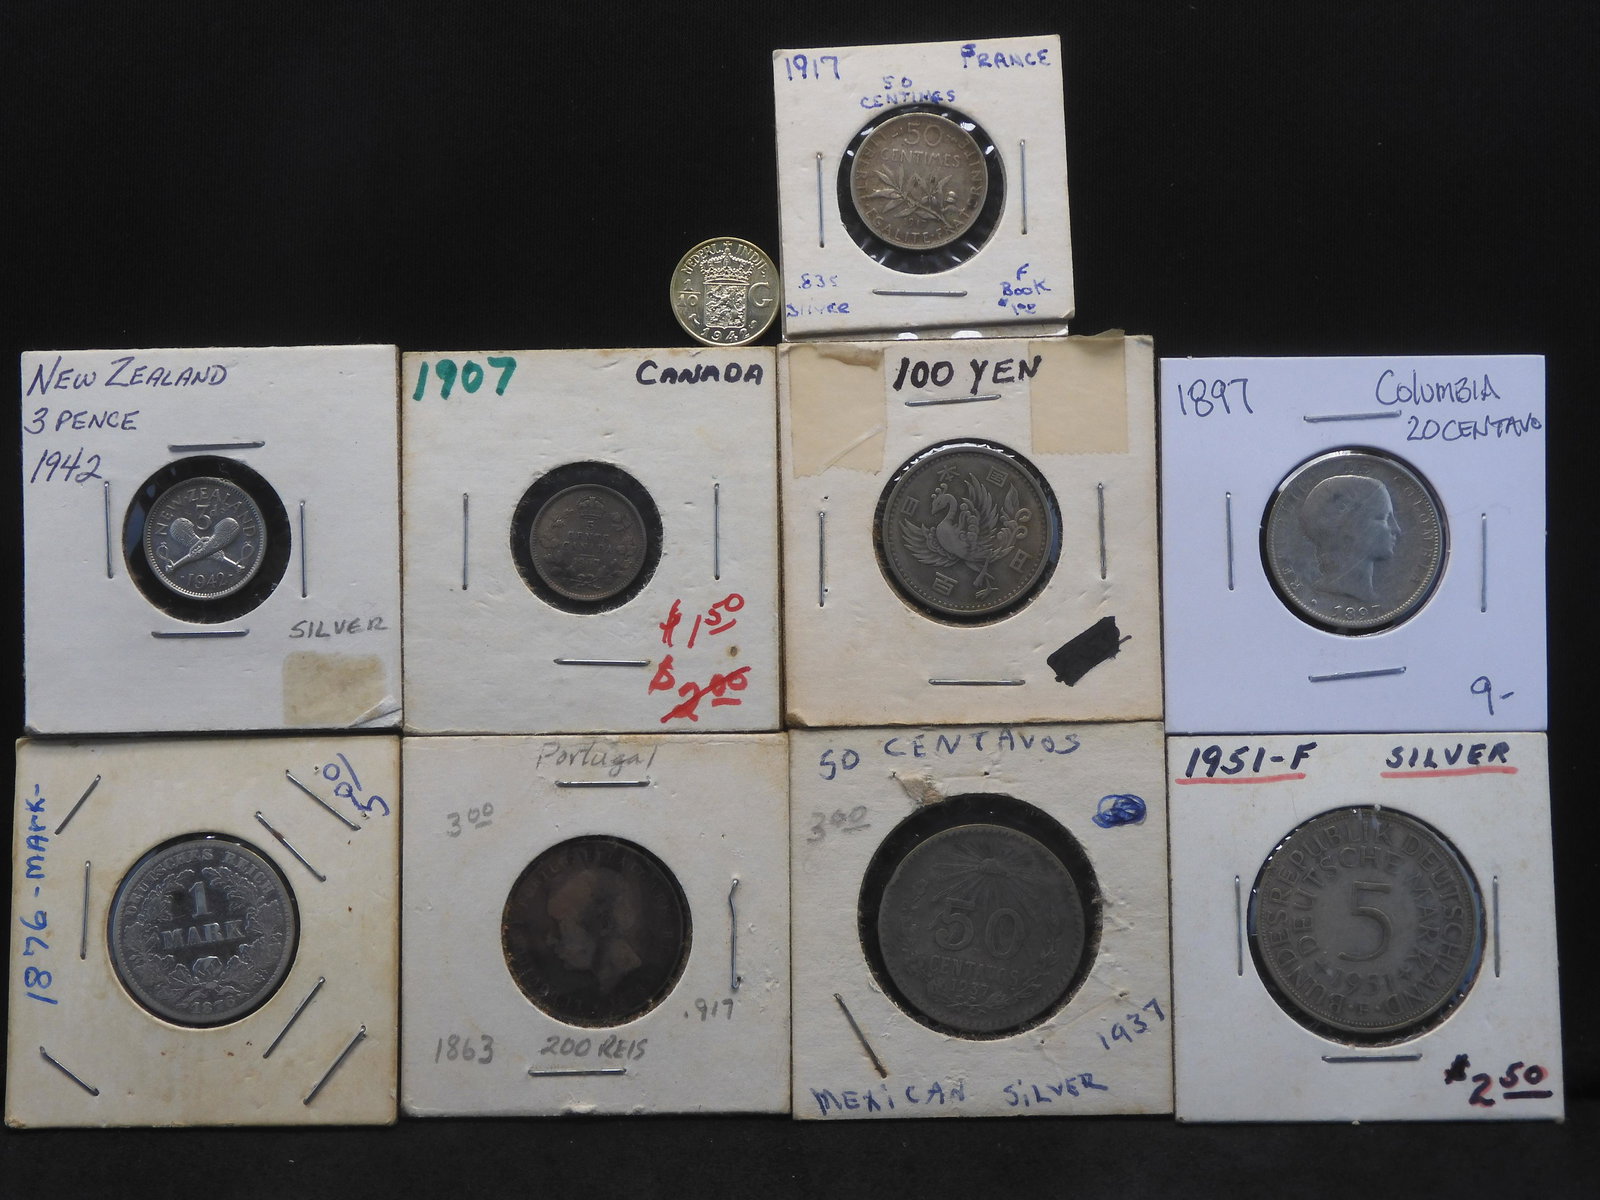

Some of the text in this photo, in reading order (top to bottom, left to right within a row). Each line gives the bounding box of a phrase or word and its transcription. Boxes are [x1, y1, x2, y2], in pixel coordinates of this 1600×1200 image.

[785, 54, 840, 80] 1917
[961, 43, 1051, 69] FRANCE
[860, 90, 956, 109] CENTIMES
[904, 122, 943, 147] 50
[880, 147, 961, 168] CENTIMES
[748, 281, 773, 307] G
[26, 355, 227, 397] NEW ZEALAND
[412, 356, 517, 401] 1907
[636, 360, 763, 386] CANADA
[892, 355, 1042, 395] 100 YEN
[1178, 378, 1253, 417] 1897
[24, 407, 140, 435] 3 PENCE
[30, 447, 103, 484] 1942
[289, 616, 389, 639] SILVER
[536, 742, 658, 777] Portugal
[820, 728, 1081, 780] 50 CENTAVOS
[1185, 742, 1317, 777] 1951-F
[1386, 742, 1510, 768] SILVER
[189, 881, 213, 919] 1
[160, 919, 247, 951] MARK
[935, 897, 1025, 961] 50
[1337, 880, 1393, 963] 5
[684, 999, 734, 1021] .917
[1101, 999, 1164, 1051] 1937
[435, 1034, 494, 1064] 1863
[540, 1034, 648, 1061] 200 REIS
